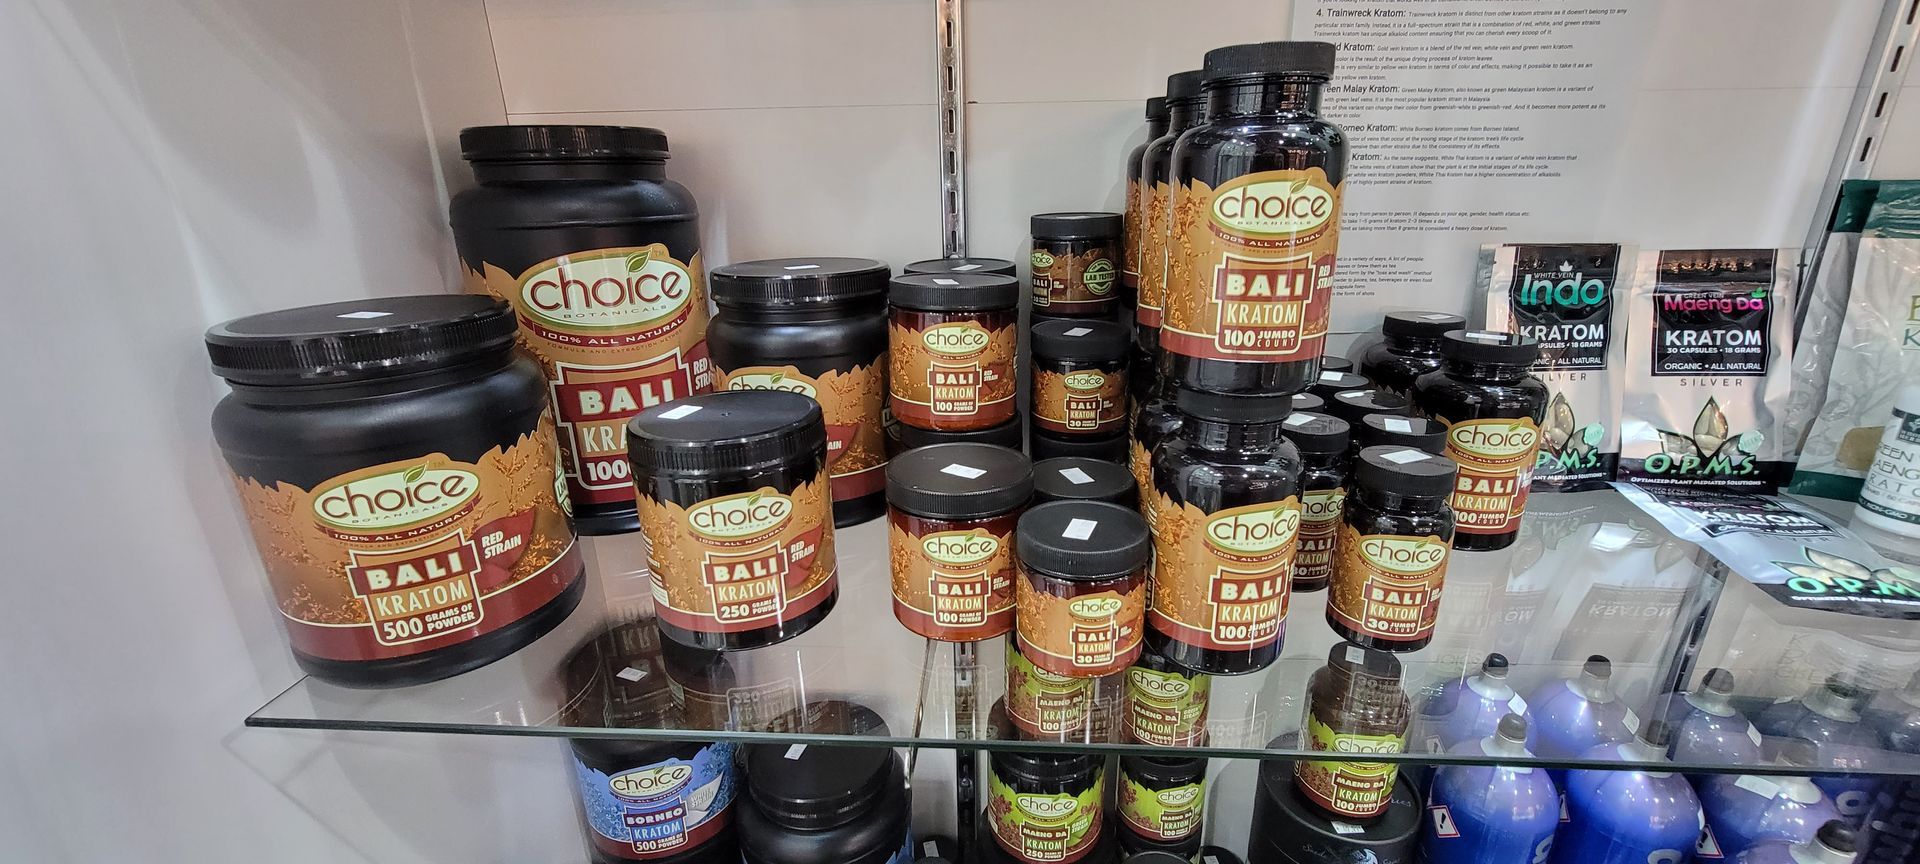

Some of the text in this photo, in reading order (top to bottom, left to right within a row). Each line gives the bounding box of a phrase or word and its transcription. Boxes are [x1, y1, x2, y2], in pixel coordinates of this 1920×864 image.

[1327, 8, 1371, 17] Trainwreck
[1374, 8, 1406, 17] Kratom:
[1343, 42, 1375, 51] Kratom:
[1343, 84, 1367, 94] Malay
[1369, 84, 1400, 93] Kratom:
[1366, 123, 1398, 132] Kratom:
[1352, 152, 1382, 161] Kratom:
[1219, 186, 1327, 219] choice
[1219, 232, 1245, 244] 100%
[1275, 233, 1321, 247] NATURAL
[530, 267, 683, 311] choice
[1226, 273, 1305, 297] BALI
[1520, 272, 1605, 306] Indo
[563, 305, 667, 319] BOTANICALS
[1664, 294, 1764, 313] Maeng Da
[1226, 303, 1297, 324] KRATOM
[541, 331, 581, 344] 100%
[626, 317, 683, 343] NATURAL
[926, 329, 984, 346] choice
[1223, 329, 1295, 347] 100 JUMBO
[1520, 324, 1604, 341] KRATOM
[1665, 329, 1762, 346] KRATOM
[1257, 339, 1295, 347] COUNT
[693, 357, 709, 375] RED
[935, 373, 974, 385] BALI
[1066, 375, 1102, 385] choice
[1680, 378, 1743, 387] SILVER
[578, 378, 674, 416] BALI
[935, 387, 974, 399] KRATOM
[936, 402, 952, 411] 100
[1070, 401, 1096, 409] BALI
[1070, 410, 1096, 419] KRATOM
[1457, 426, 1533, 447] choice
[1644, 453, 1760, 475] O.P.M.S.
[1457, 476, 1514, 494] BALI
[322, 475, 469, 518] choice
[1457, 495, 1507, 510] KRATOM
[352, 502, 448, 524] BOTANICALS
[694, 501, 785, 529] choice
[1456, 511, 1477, 523] 100
[334, 533, 369, 541] 100%
[408, 510, 469, 536] NATURAL
[1213, 513, 1298, 541] choice
[482, 531, 504, 548] RED
[745, 526, 785, 545] NATURAL
[484, 534, 522, 559] STRAIN
[791, 541, 805, 553] RED
[791, 544, 815, 562] STRAIN
[926, 537, 992, 556] choice
[1365, 540, 1441, 564] choice
[365, 552, 463, 590] BALI
[713, 557, 778, 582] BALI
[718, 577, 777, 602] KRATOM
[938, 583, 981, 596] BALI
[1220, 575, 1283, 601] BALI
[1371, 587, 1422, 605] BALI
[377, 580, 468, 616] KRATOM
[938, 598, 981, 610] KRATOM
[1073, 600, 1119, 612] choice
[720, 604, 750, 619] 250
[939, 612, 958, 622] 100
[1222, 600, 1277, 622] KRATOM
[1370, 604, 1418, 620] KRATOM
[384, 603, 473, 640] 500 GRAMS OF
[427, 612, 475, 632] POWDER
[1367, 618, 1388, 631] 30
[1078, 631, 1112, 642] BALI
[1219, 625, 1247, 639] 100
[1077, 655, 1093, 664] 30
[1132, 671, 1185, 692] choice
[1044, 707, 1079, 720] KRATOM
[1042, 722, 1059, 730] 100
[1136, 727, 1150, 740] 100
[1137, 717, 1172, 734] KRATOM
[613, 767, 686, 791] choice
[1160, 789, 1197, 801] choice
[1339, 788, 1378, 801] KRATOM
[1020, 796, 1073, 811] choice
[1336, 800, 1355, 811] 100
[627, 807, 683, 825] BORNEO
[634, 821, 681, 840] KRATOM
[1164, 820, 1189, 830] KRATOM
[636, 840, 656, 851] 500
[658, 838, 684, 849] POWDER
[1026, 839, 1061, 850] KRATOM
[1026, 849, 1043, 858] 250
